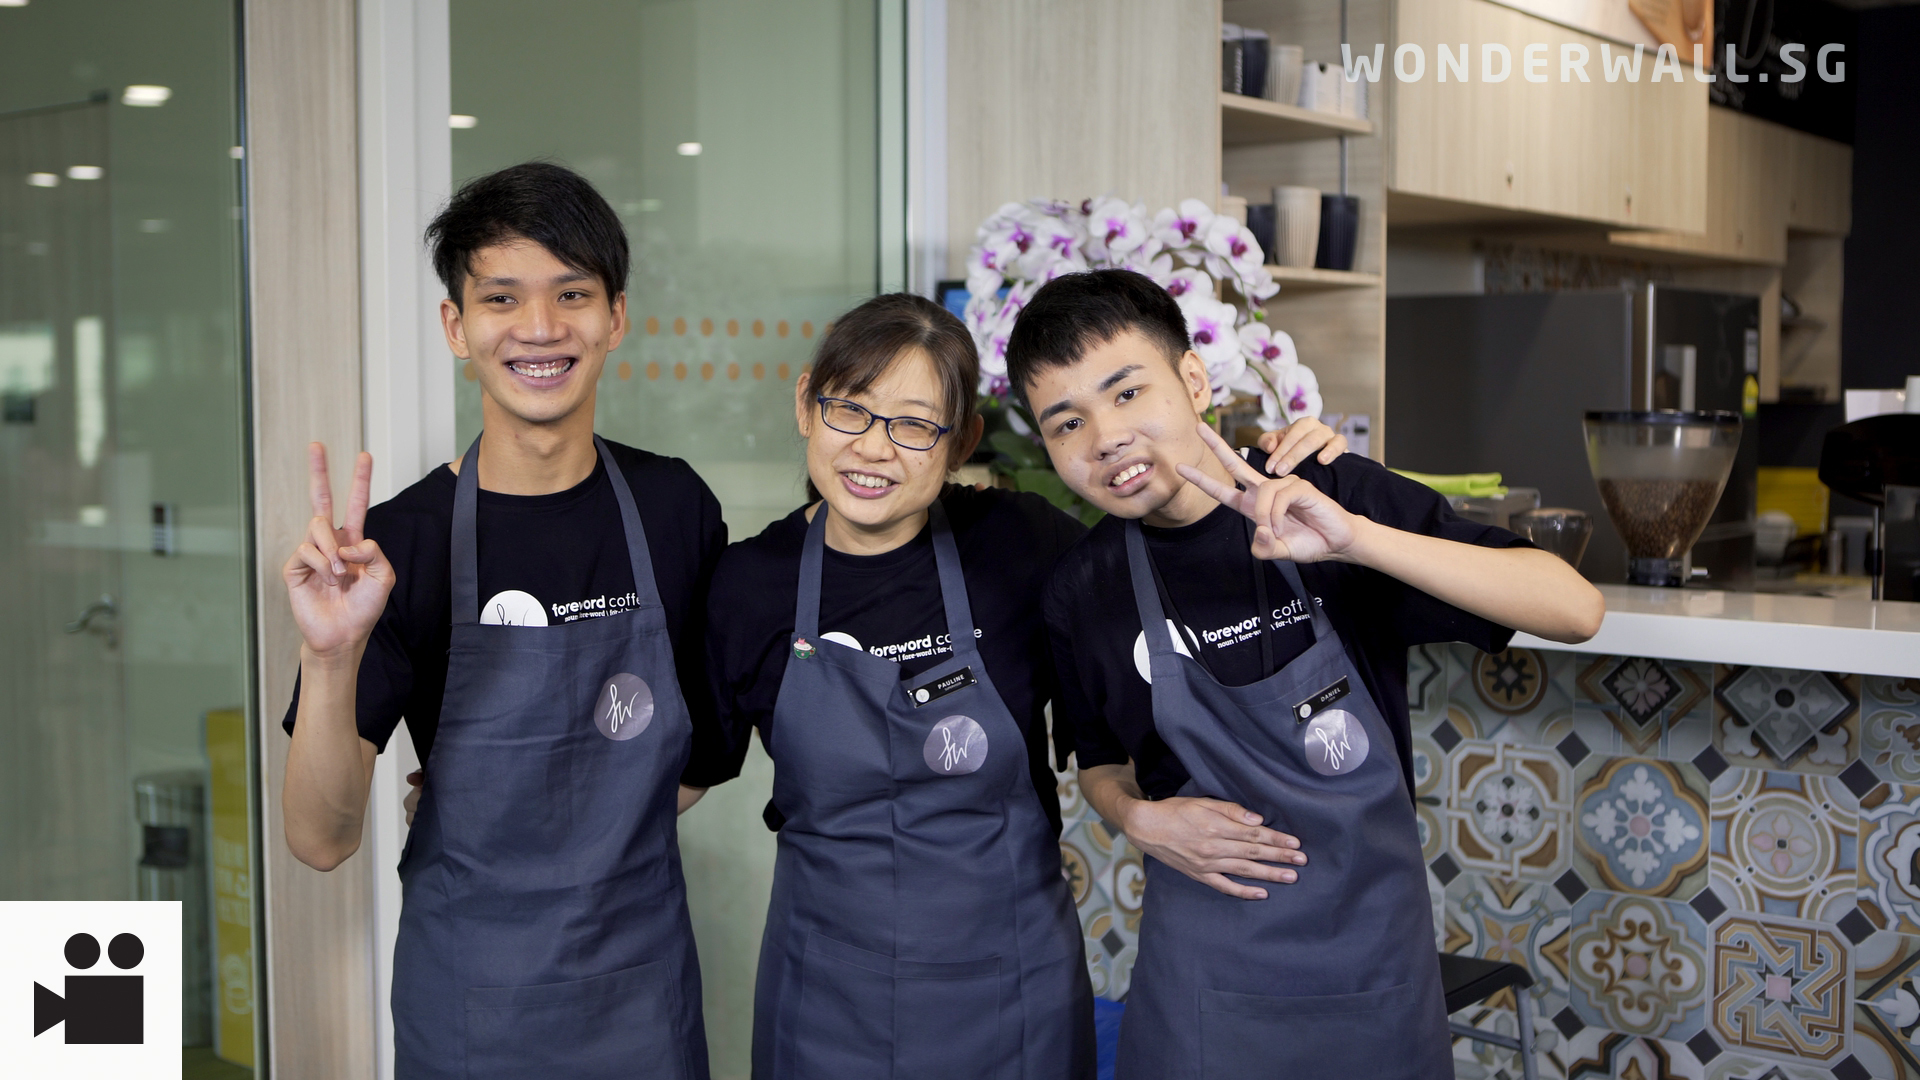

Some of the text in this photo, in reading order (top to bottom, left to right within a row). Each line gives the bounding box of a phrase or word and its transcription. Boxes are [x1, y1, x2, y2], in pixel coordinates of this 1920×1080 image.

[609, 592, 641, 608] coffe
[1202, 596, 1323, 644] forewor coffe
[869, 634, 932, 658] foreword
[1217, 639, 1234, 649] noun
[937, 674, 965, 690] PAULINE
[1320, 687, 1341, 703] DANIEL
